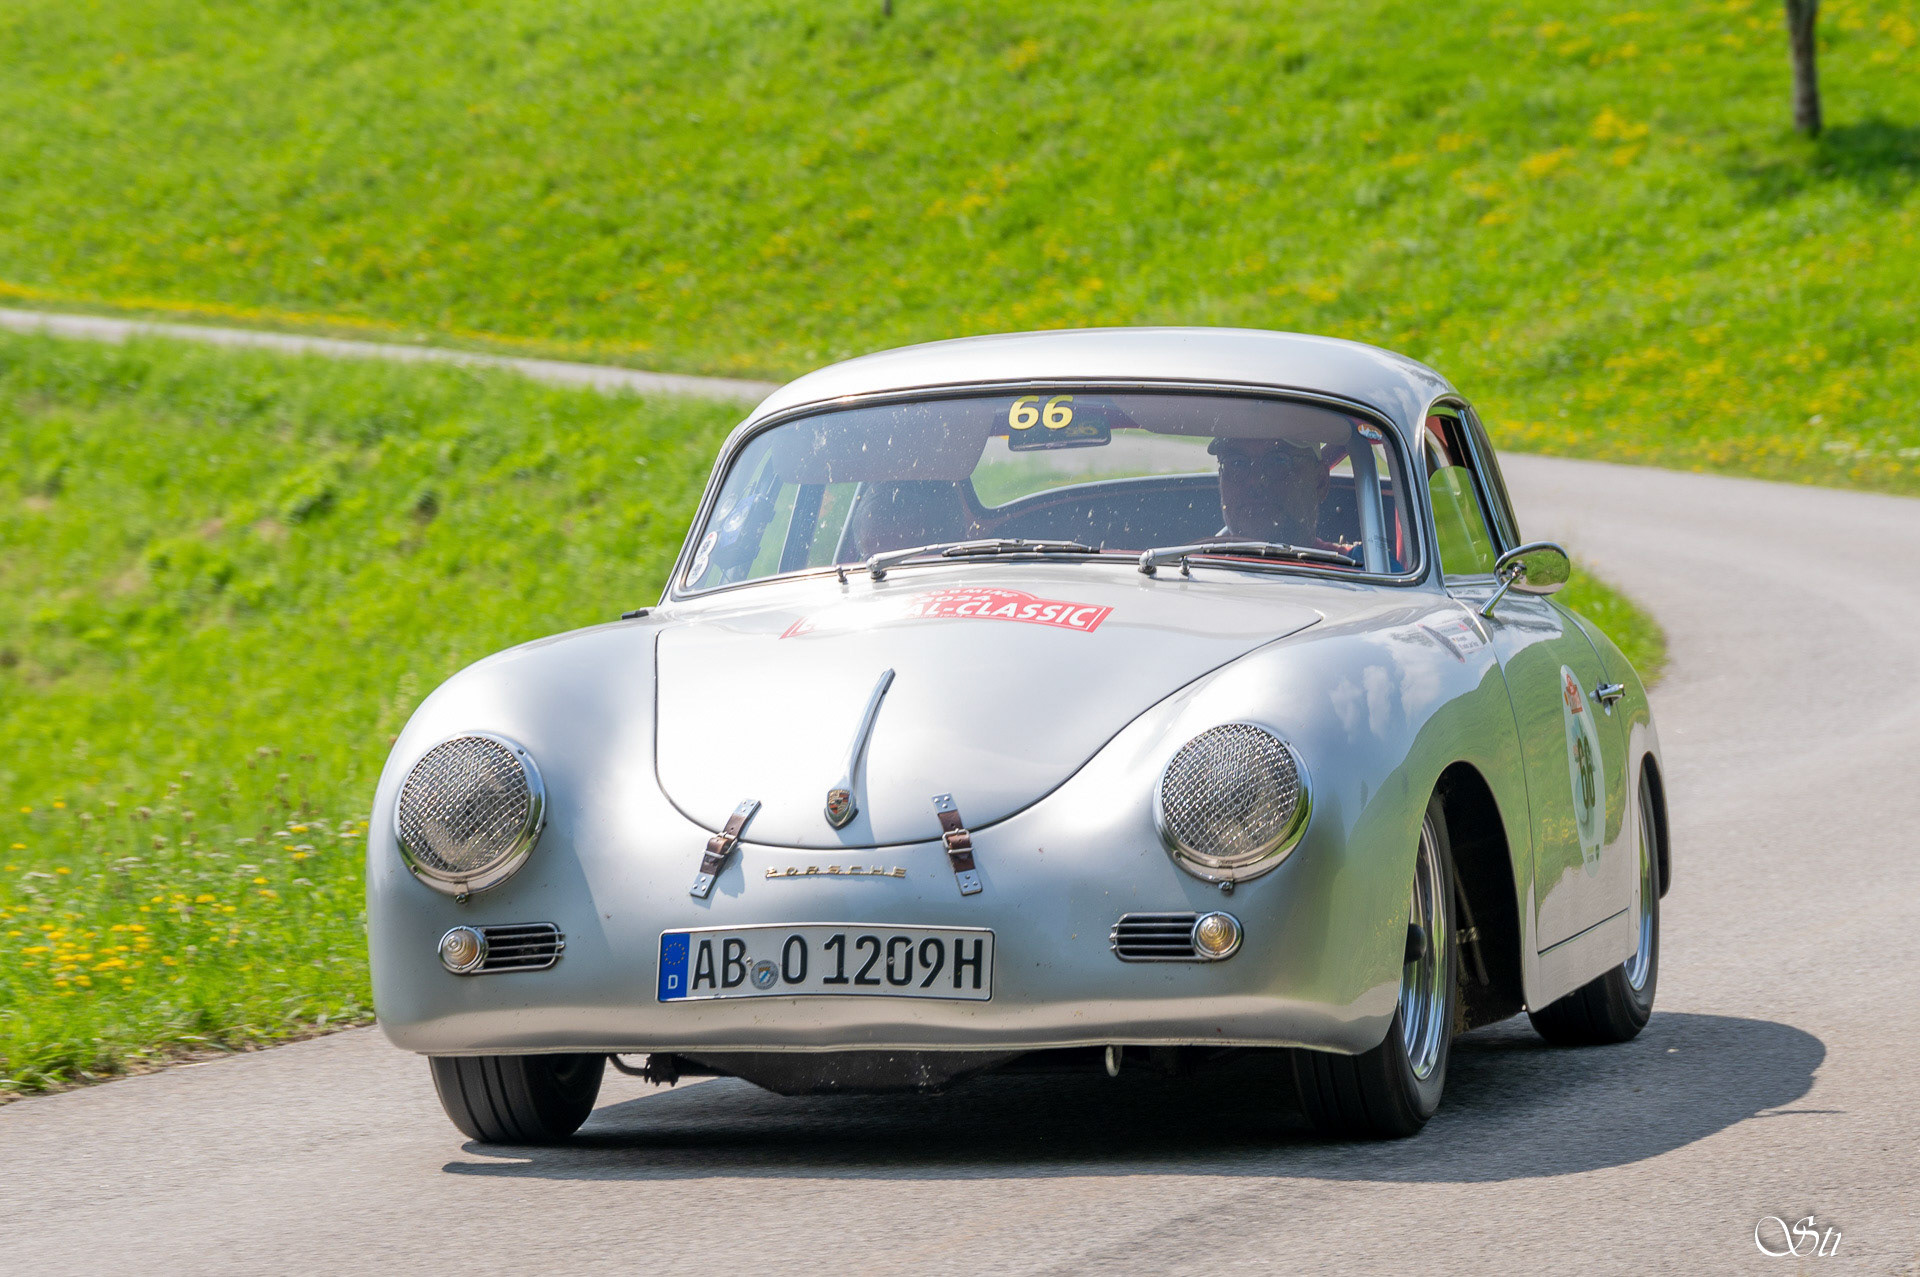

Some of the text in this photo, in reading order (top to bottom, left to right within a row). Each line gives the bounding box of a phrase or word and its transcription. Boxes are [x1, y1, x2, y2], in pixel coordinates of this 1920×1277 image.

[1008, 395, 1074, 430] 66
[1577, 735, 1596, 809] 66
[667, 974, 679, 990] D
[691, 938, 747, 990] AB
[822, 933, 983, 990] 1209H
